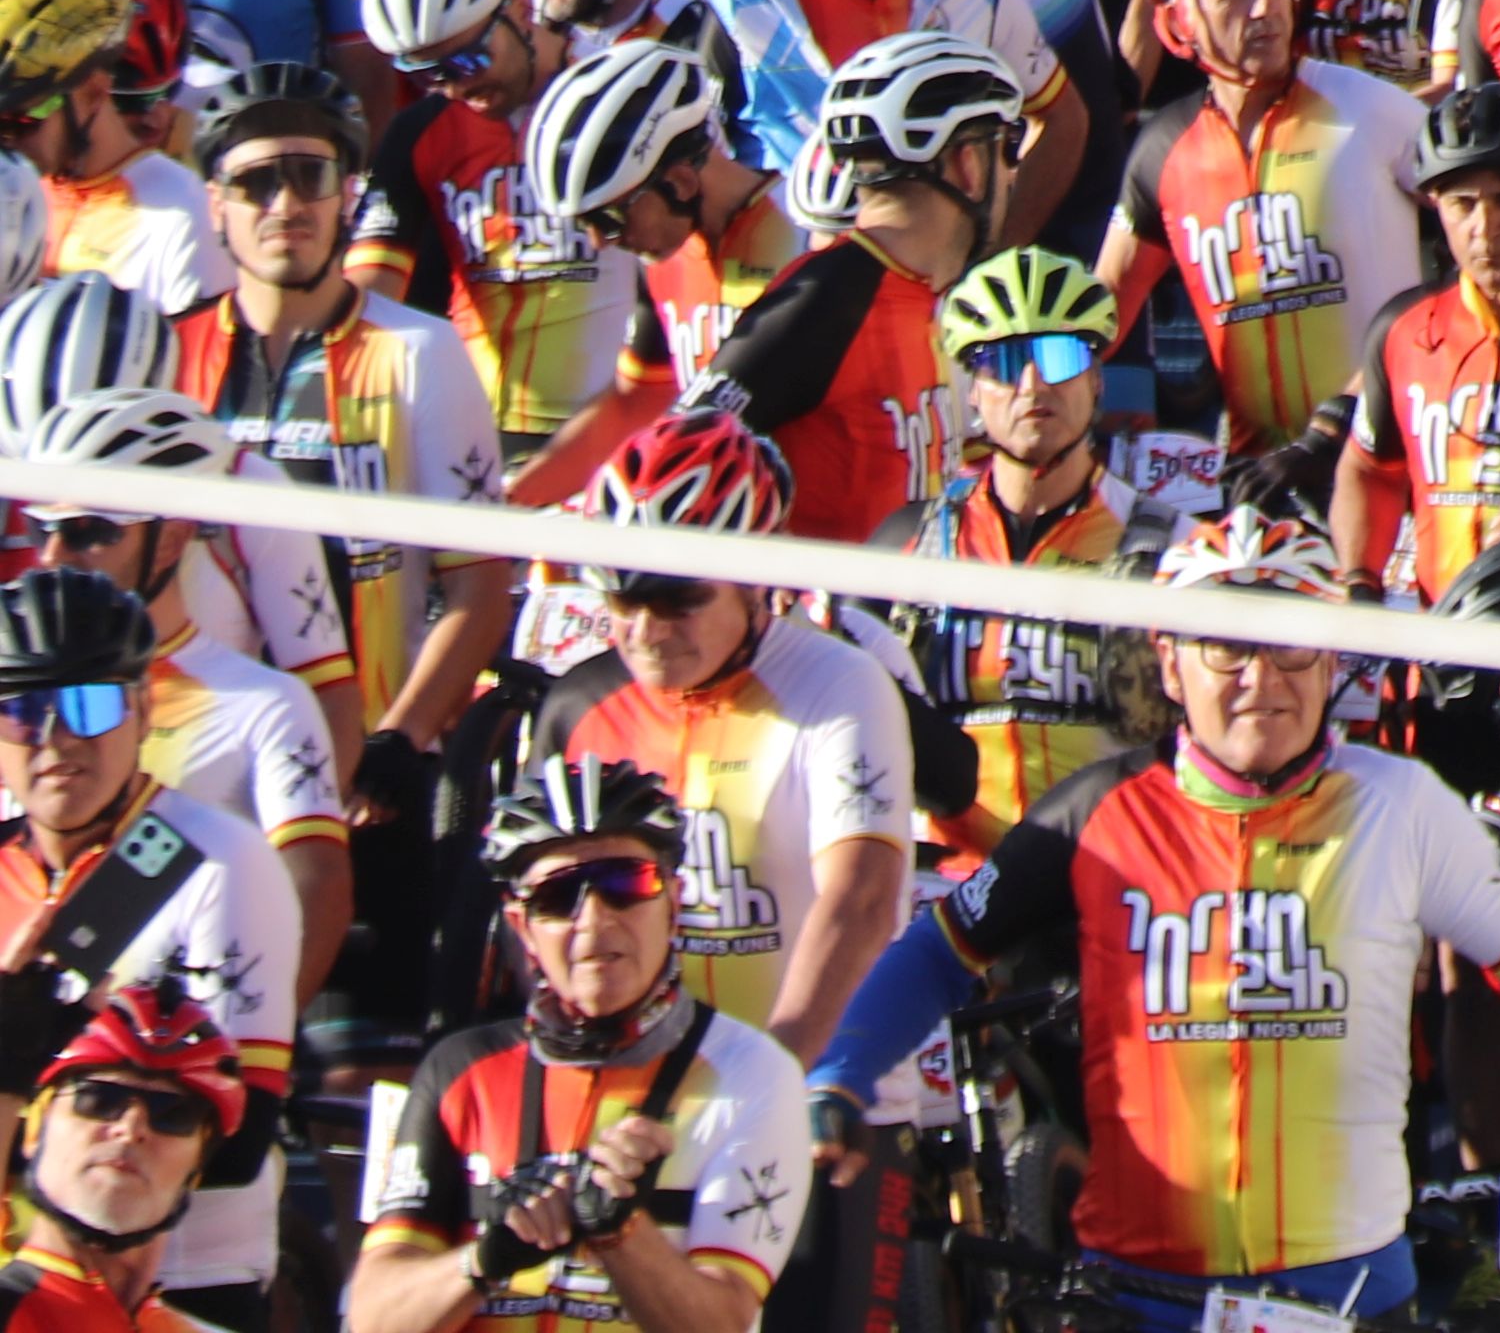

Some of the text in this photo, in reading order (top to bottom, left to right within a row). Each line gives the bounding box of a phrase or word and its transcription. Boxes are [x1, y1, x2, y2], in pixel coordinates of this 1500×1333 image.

[734, 932, 782, 954] UNE
[1228, 947, 1349, 1013] 24h
[1146, 1021, 1180, 1041] LA
[1252, 1020, 1300, 1040] NOS
[1306, 1018, 1347, 1039] UNE
[569, 1298, 615, 1321] NOS
